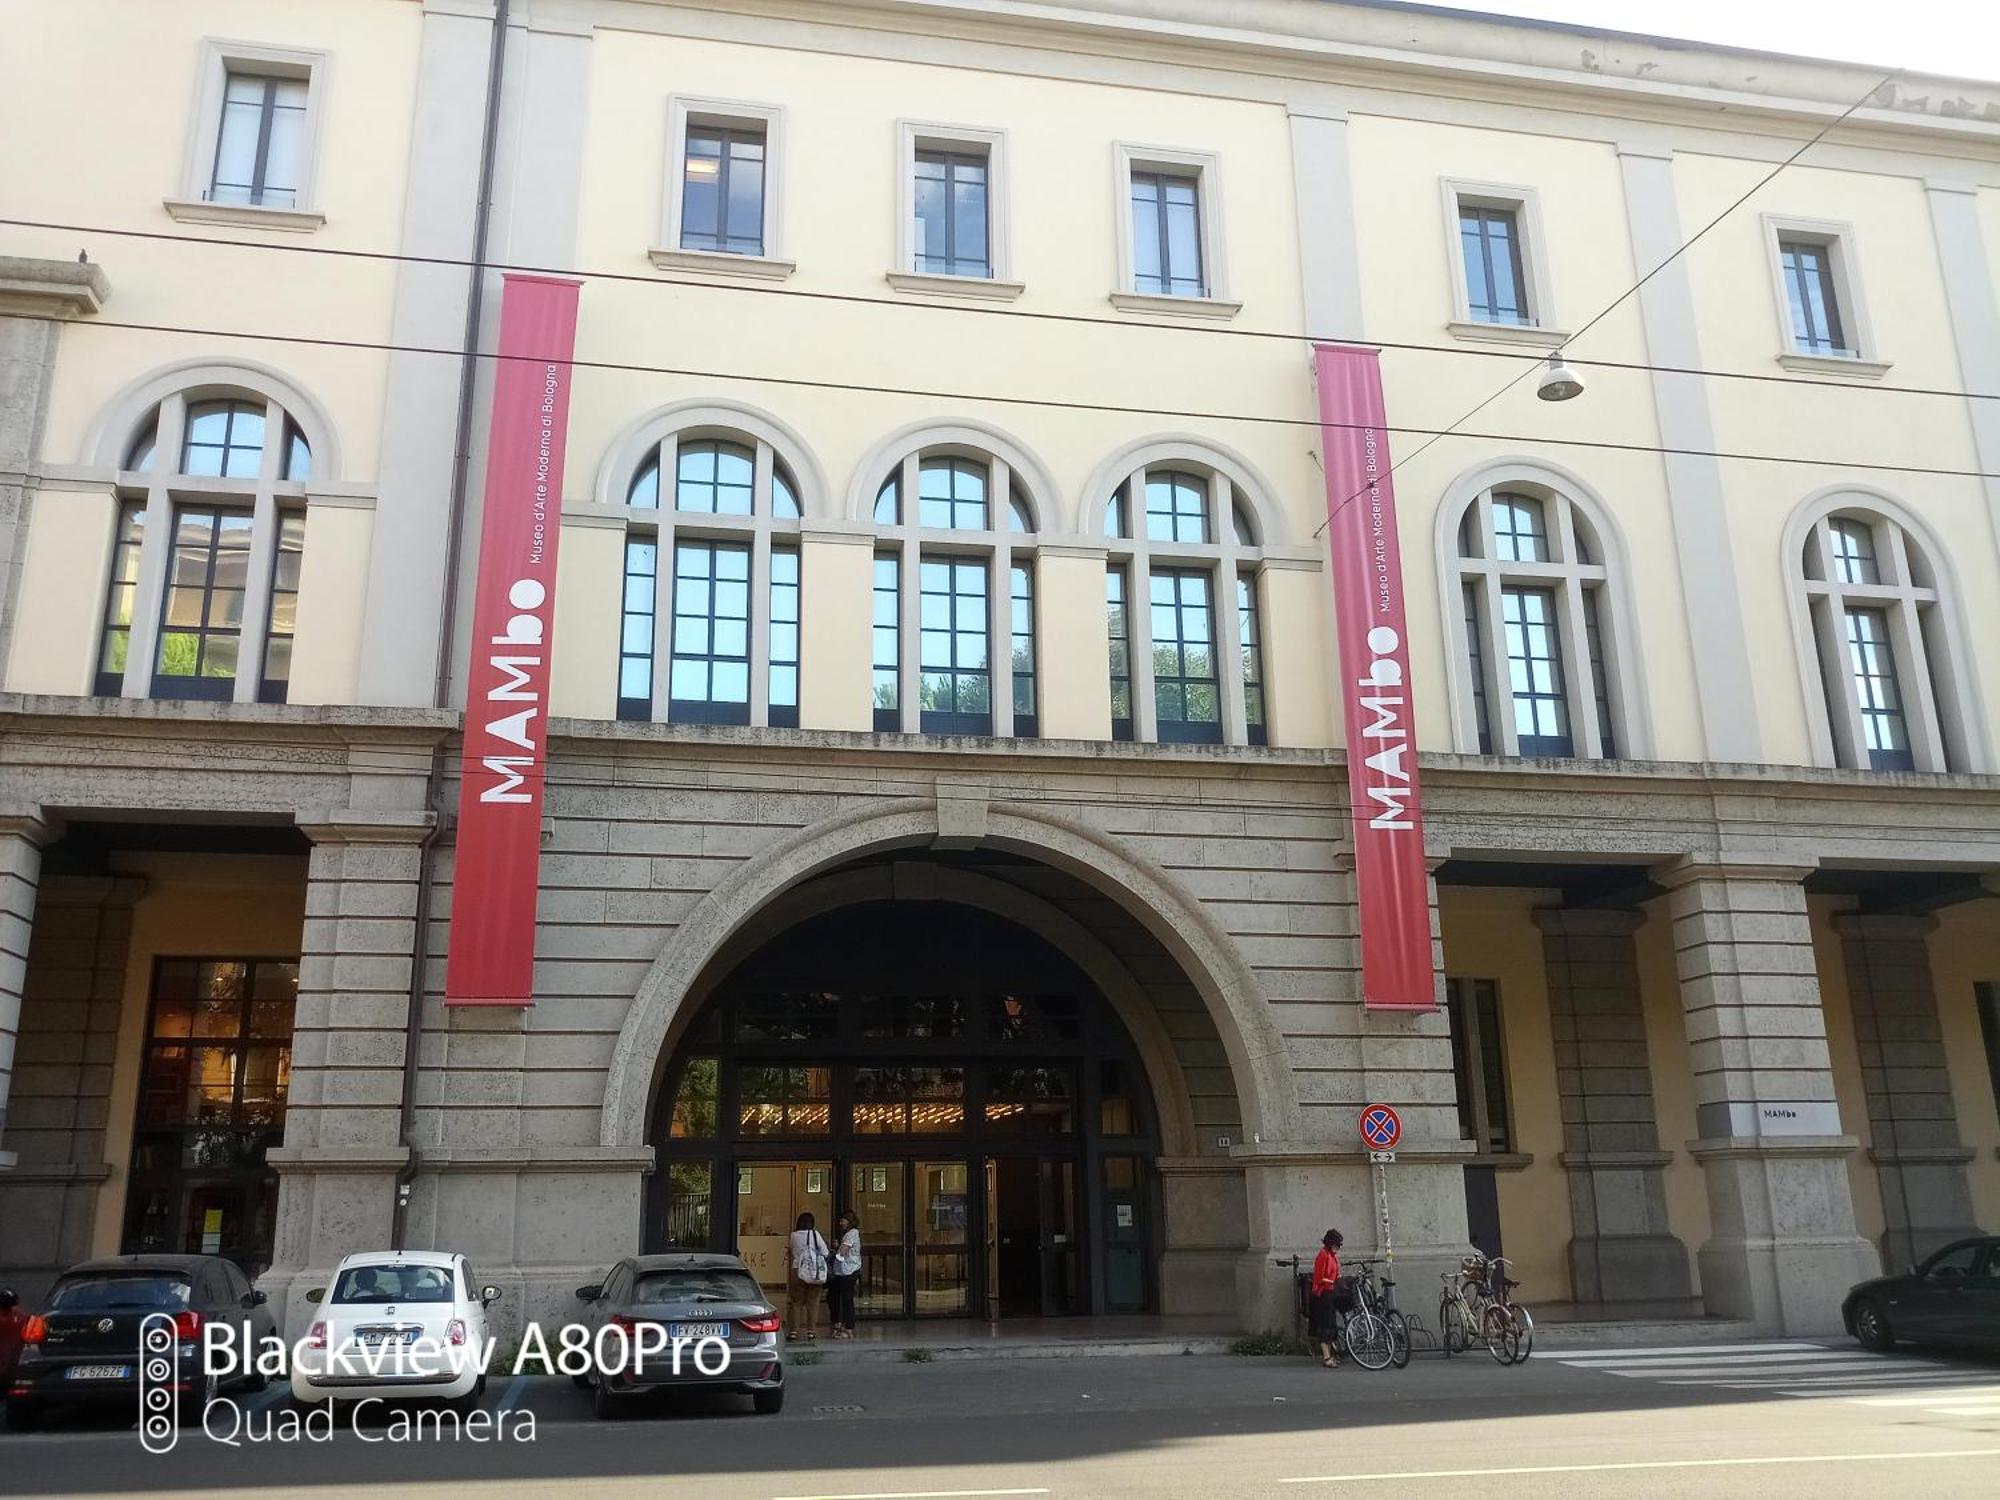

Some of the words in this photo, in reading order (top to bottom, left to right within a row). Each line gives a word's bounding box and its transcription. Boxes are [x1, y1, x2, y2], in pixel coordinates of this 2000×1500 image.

[542, 364, 558, 413] Bologna
[541, 415, 553, 427] di
[536, 429, 552, 482] Moderna
[1364, 428, 1378, 472] Bologna
[533, 485, 548, 521] d'Arte
[1371, 487, 1384, 538] Moderna
[530, 522, 545, 564] Museo
[1375, 539, 1388, 573] d'Arte
[1379, 575, 1390, 612] Museo
[479, 578, 547, 804] MAMbo
[1357, 625, 1414, 830] MAMbo
[1763, 1109, 1797, 1119] MAMbo
